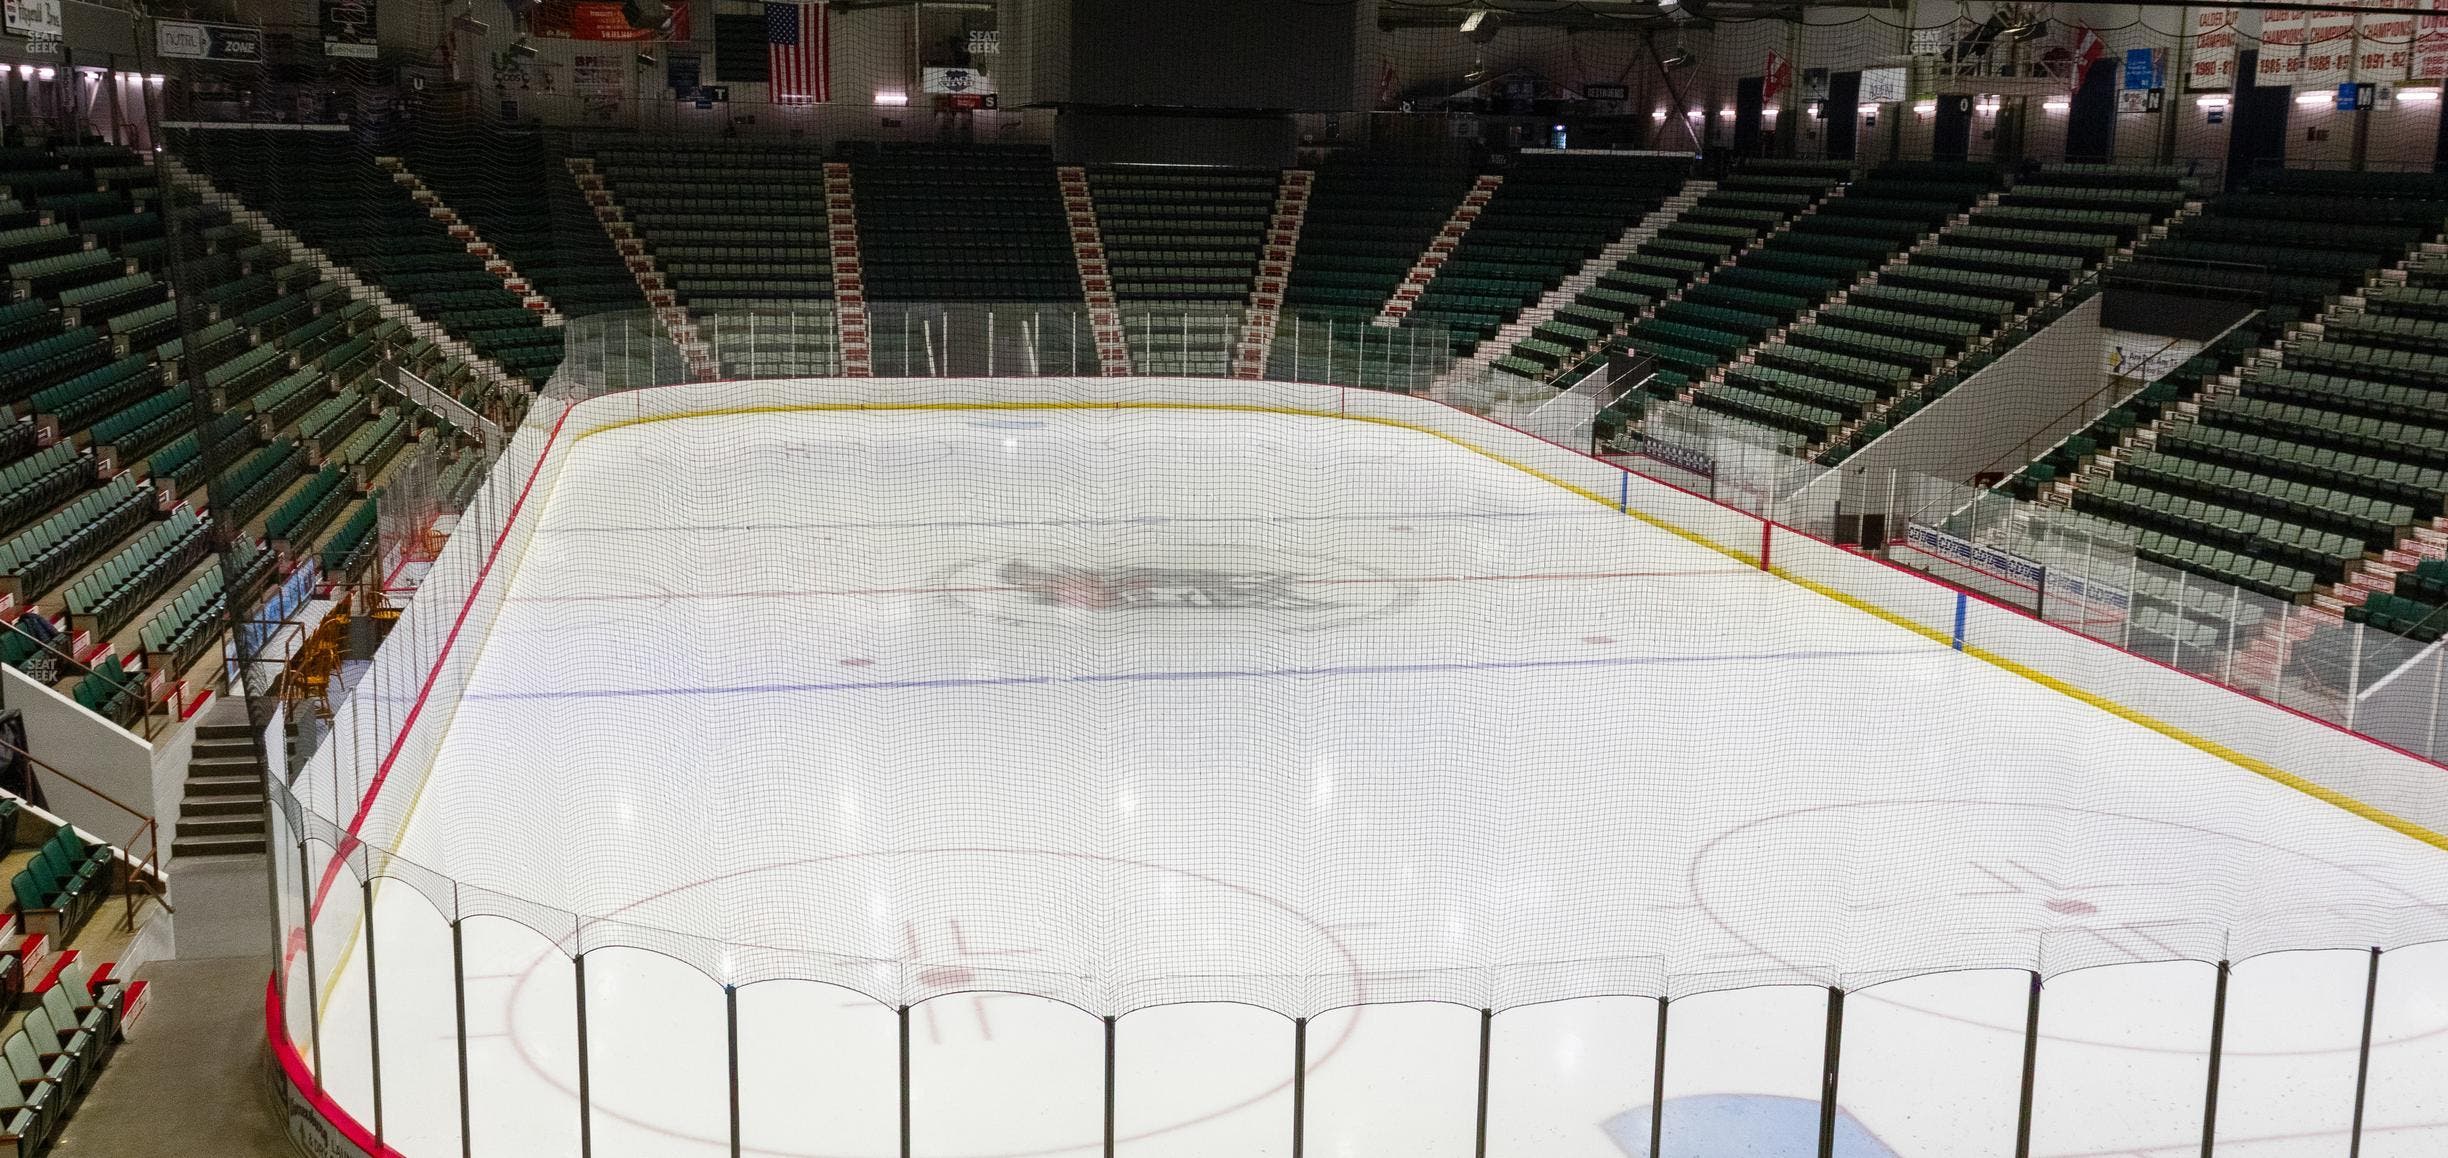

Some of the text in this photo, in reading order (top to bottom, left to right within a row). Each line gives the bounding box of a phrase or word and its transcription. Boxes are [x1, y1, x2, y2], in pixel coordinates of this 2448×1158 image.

[2200, 12, 2224, 27] CALDER
[2262, 28, 2305, 45] CHAMPIONS
[2363, 21, 2416, 39] CHAMPIONS
[225, 41, 255, 53] ZONE
[714, 88, 726, 99] T
[985, 96, 995, 107] S
[2149, 92, 2160, 109] N
[2357, 87, 2373, 106] M
